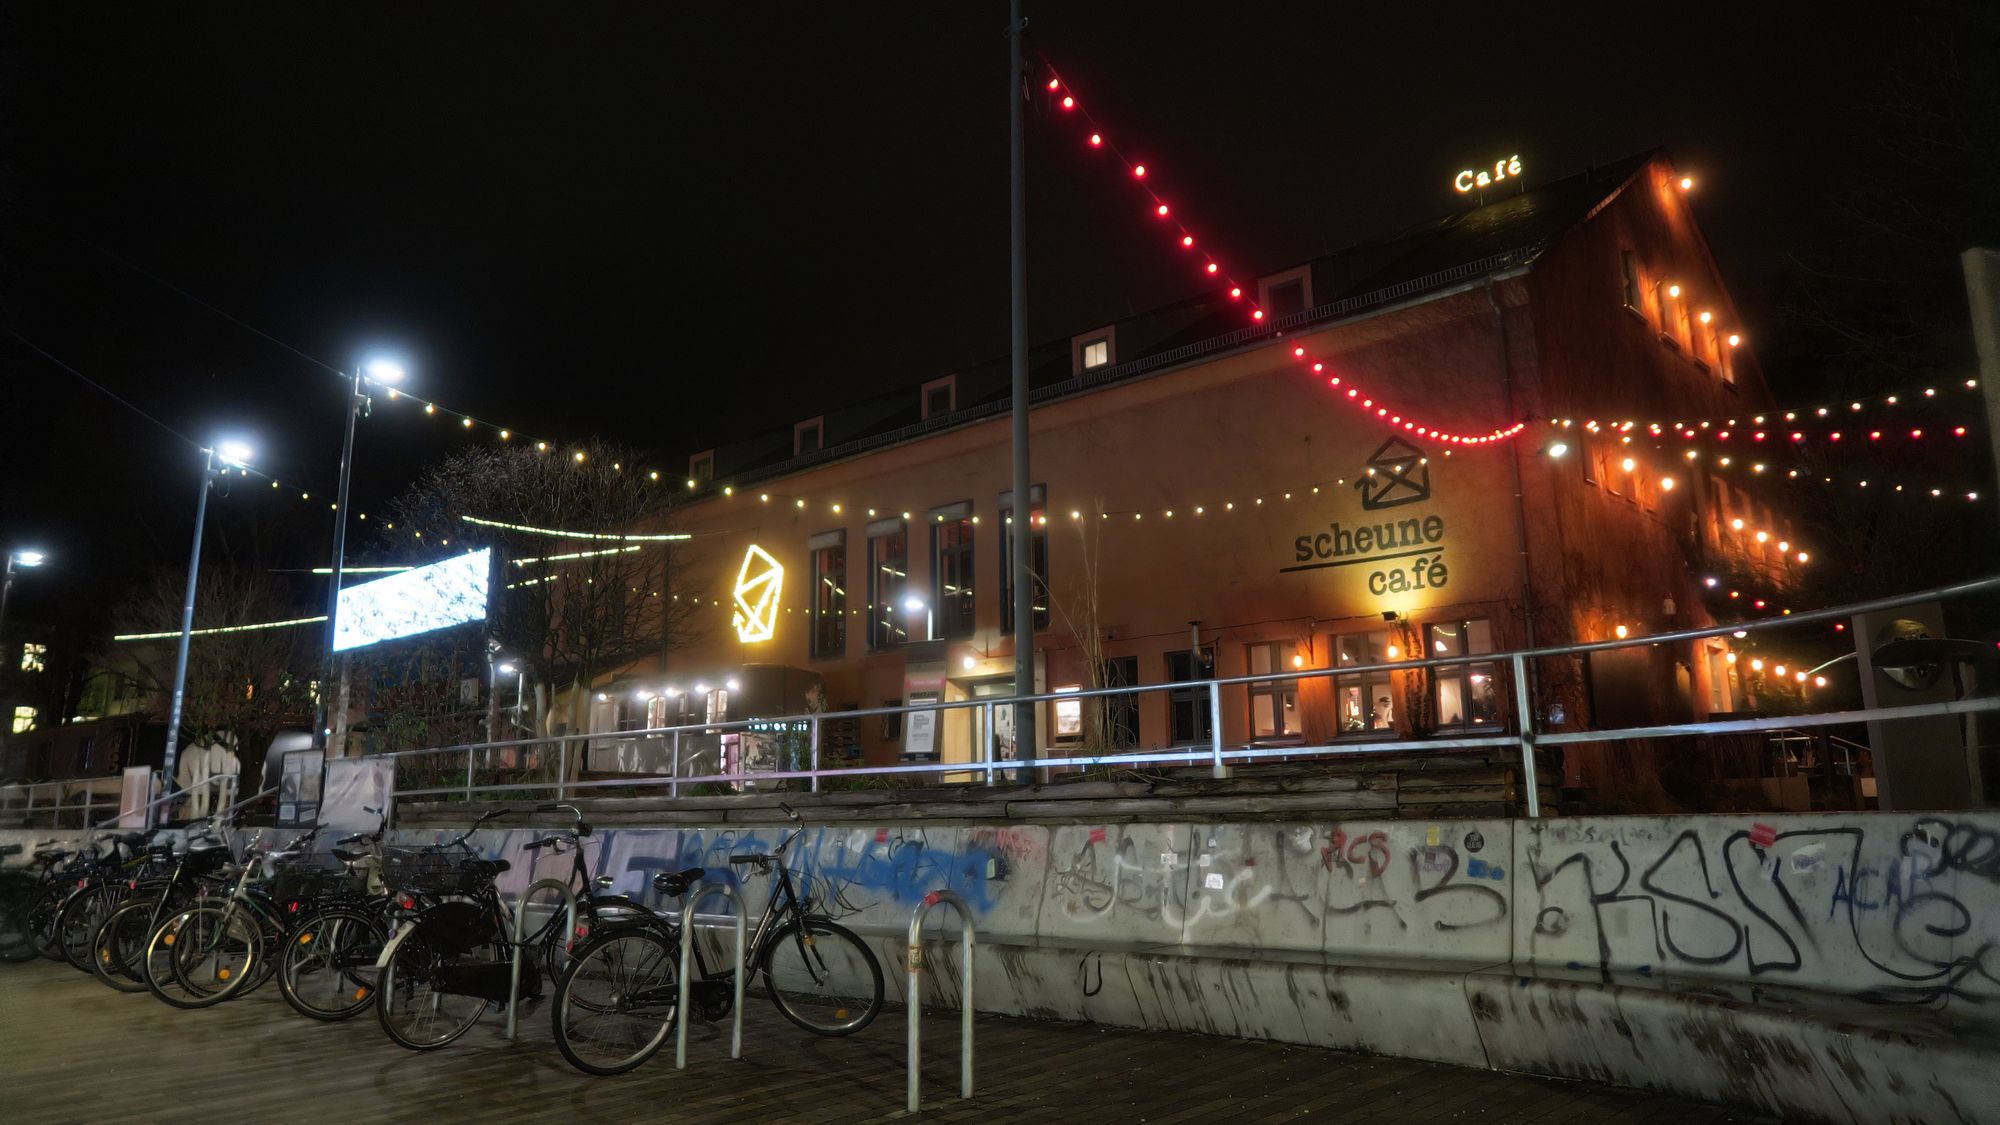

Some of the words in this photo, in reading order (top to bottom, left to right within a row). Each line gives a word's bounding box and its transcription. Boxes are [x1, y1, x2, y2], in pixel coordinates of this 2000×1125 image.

[1455, 154, 1521, 192] Café
[1295, 515, 1444, 562] scheune
[1368, 554, 1448, 596] café
